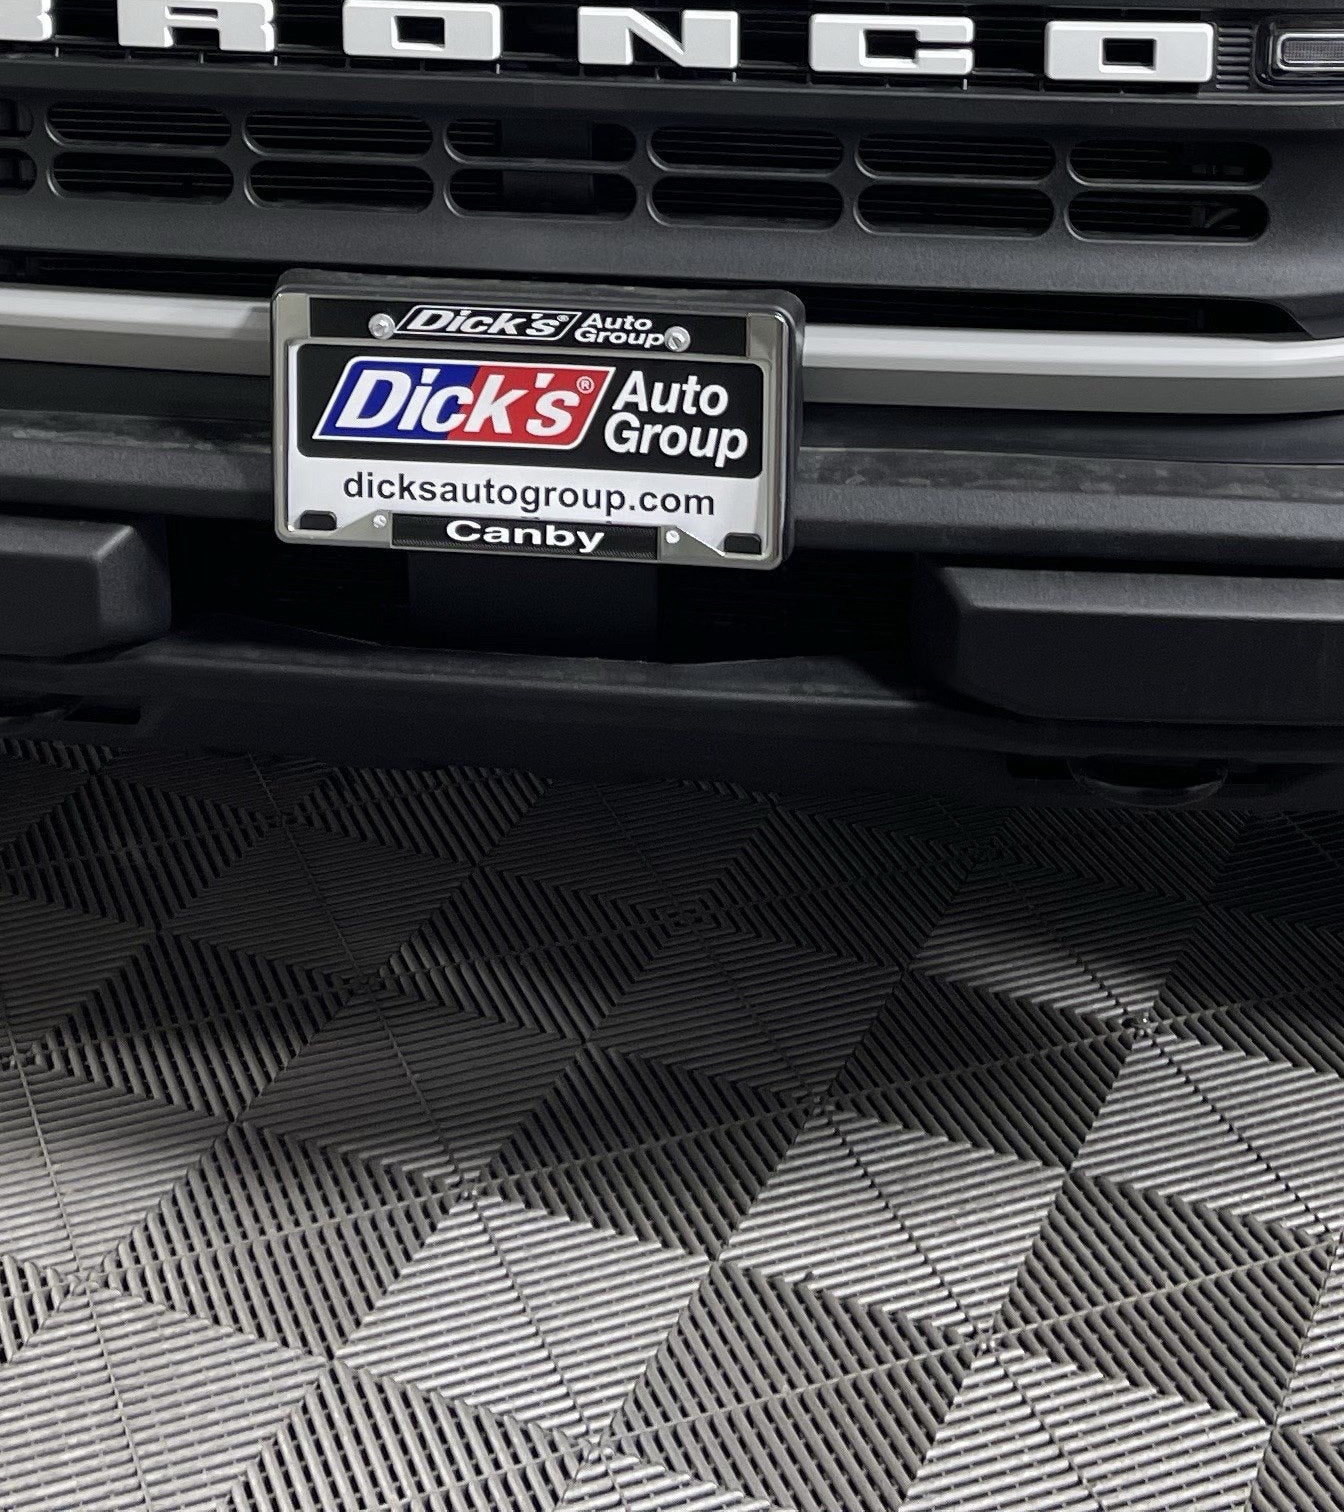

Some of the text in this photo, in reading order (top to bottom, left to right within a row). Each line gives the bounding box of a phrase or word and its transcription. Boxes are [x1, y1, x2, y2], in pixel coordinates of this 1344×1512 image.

[574, 328, 665, 349] Group
[580, 313, 653, 331] Auto
[612, 370, 729, 416] Auto
[604, 411, 749, 468] Group
[342, 471, 716, 517] dicksautogroup.com
[446, 519, 606, 554] Canby
